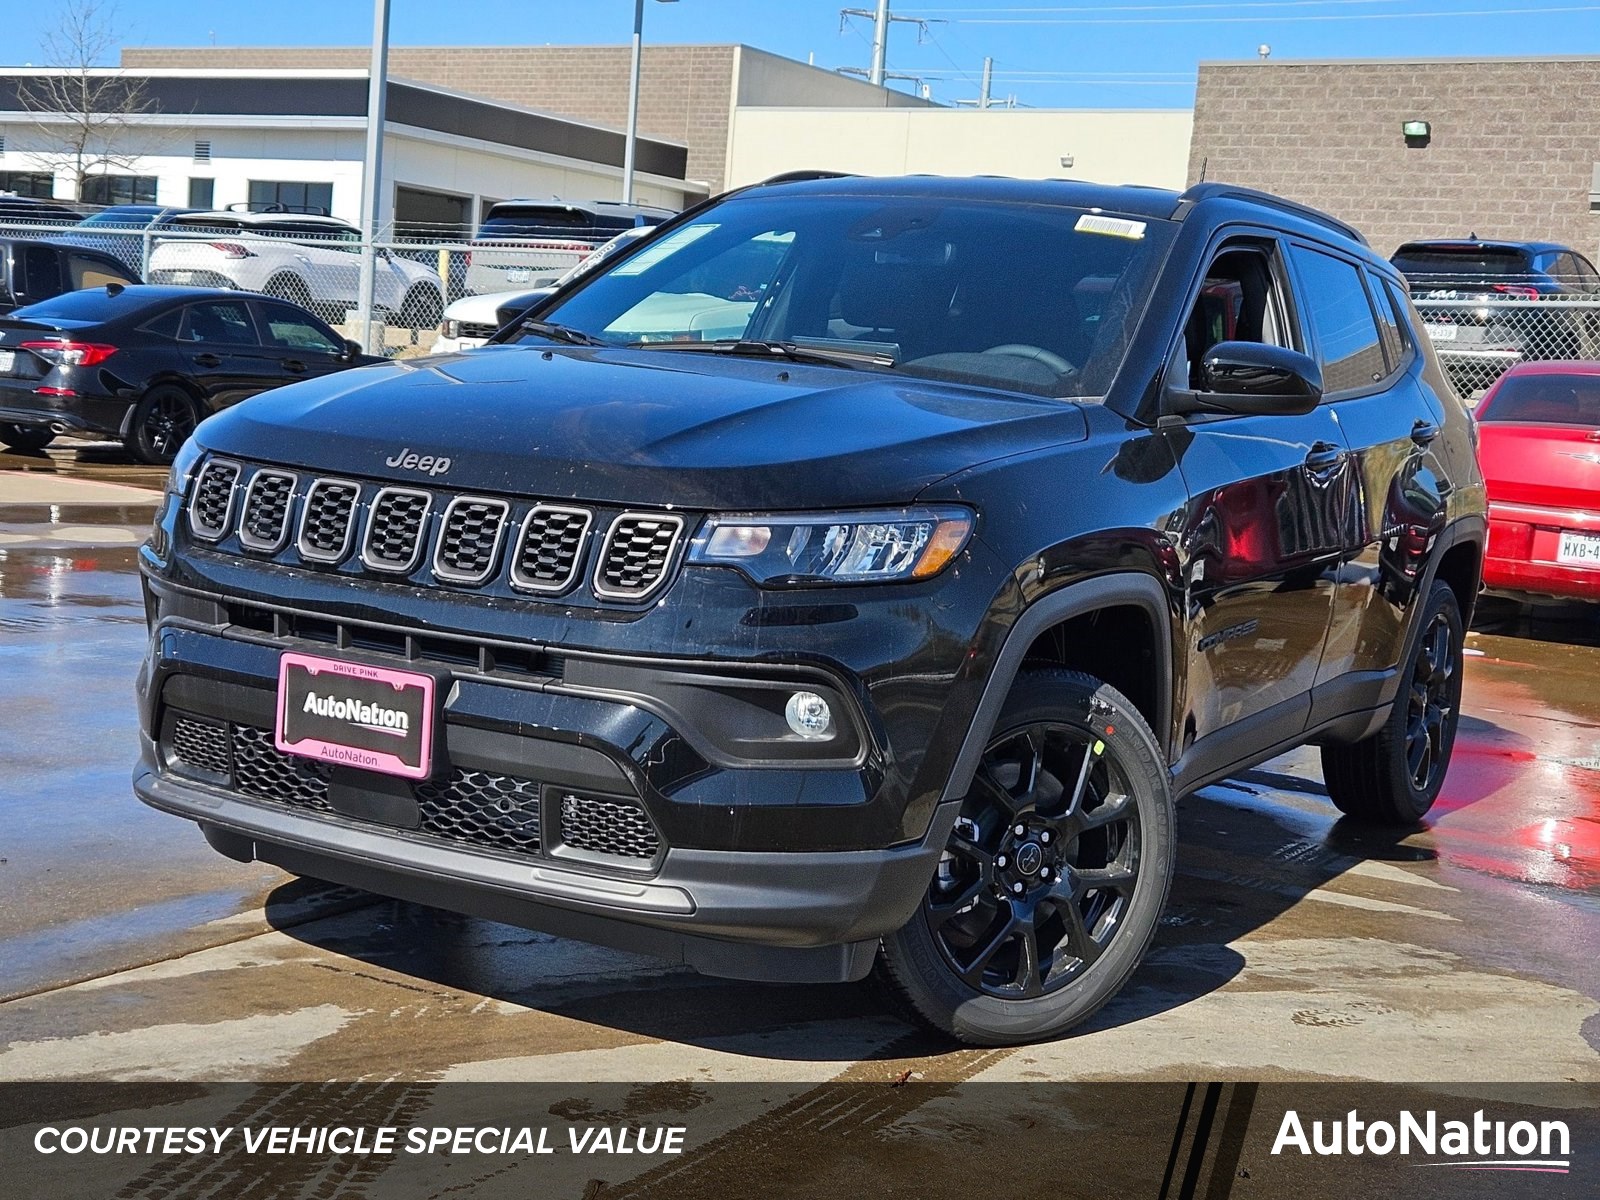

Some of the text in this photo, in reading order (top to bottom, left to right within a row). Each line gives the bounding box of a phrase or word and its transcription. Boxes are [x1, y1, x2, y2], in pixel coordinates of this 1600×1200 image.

[386, 447, 452, 476] Jeep
[333, 664, 379, 678] DRIVE PINK
[302, 691, 409, 729] AutoNation
[320, 745, 381, 767] AutoNation
